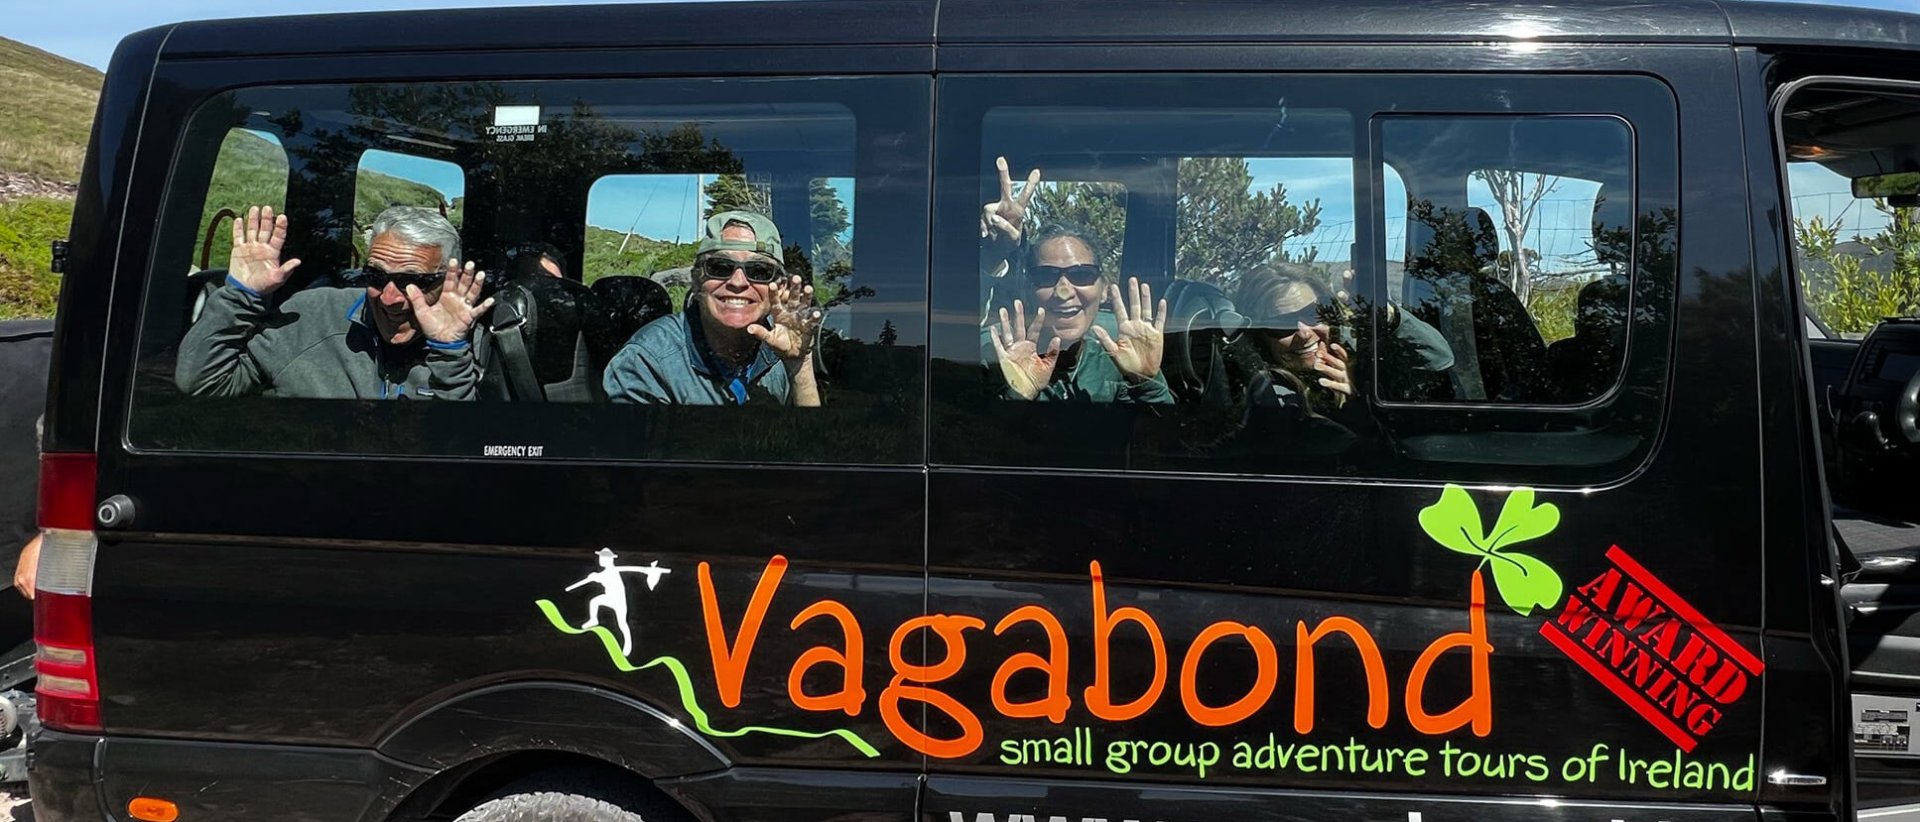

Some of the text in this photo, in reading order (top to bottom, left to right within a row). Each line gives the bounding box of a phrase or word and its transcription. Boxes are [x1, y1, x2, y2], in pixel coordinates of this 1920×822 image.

[484, 445, 544, 456] EMERGENCY EXIT
[698, 555, 1493, 760] Vagabond
[1556, 594, 1723, 737] WINNING
[1576, 567, 1748, 705] AWARD
[1000, 728, 1756, 792] small group adventure tours of Ireland
